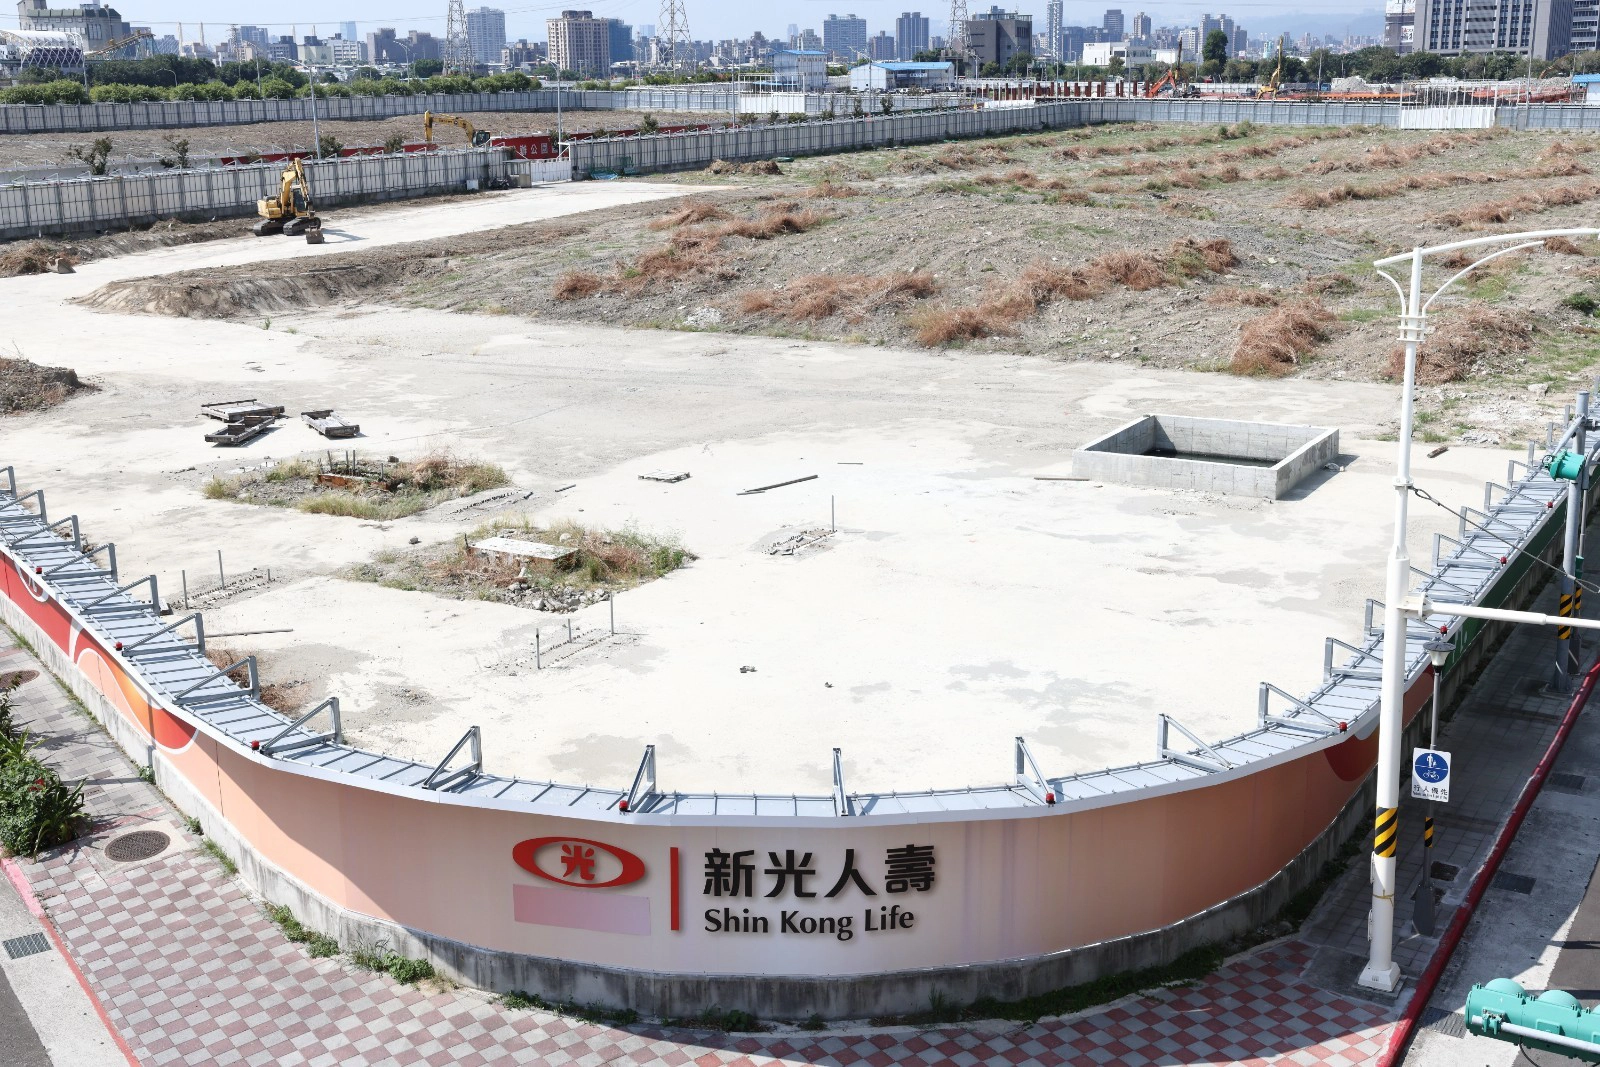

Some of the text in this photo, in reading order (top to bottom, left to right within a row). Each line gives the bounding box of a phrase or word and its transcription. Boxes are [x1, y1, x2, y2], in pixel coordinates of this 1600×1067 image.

[560, 844, 595, 880] 光
[703, 844, 935, 897] 新光人壽
[704, 904, 914, 941] Shin Kong Life
